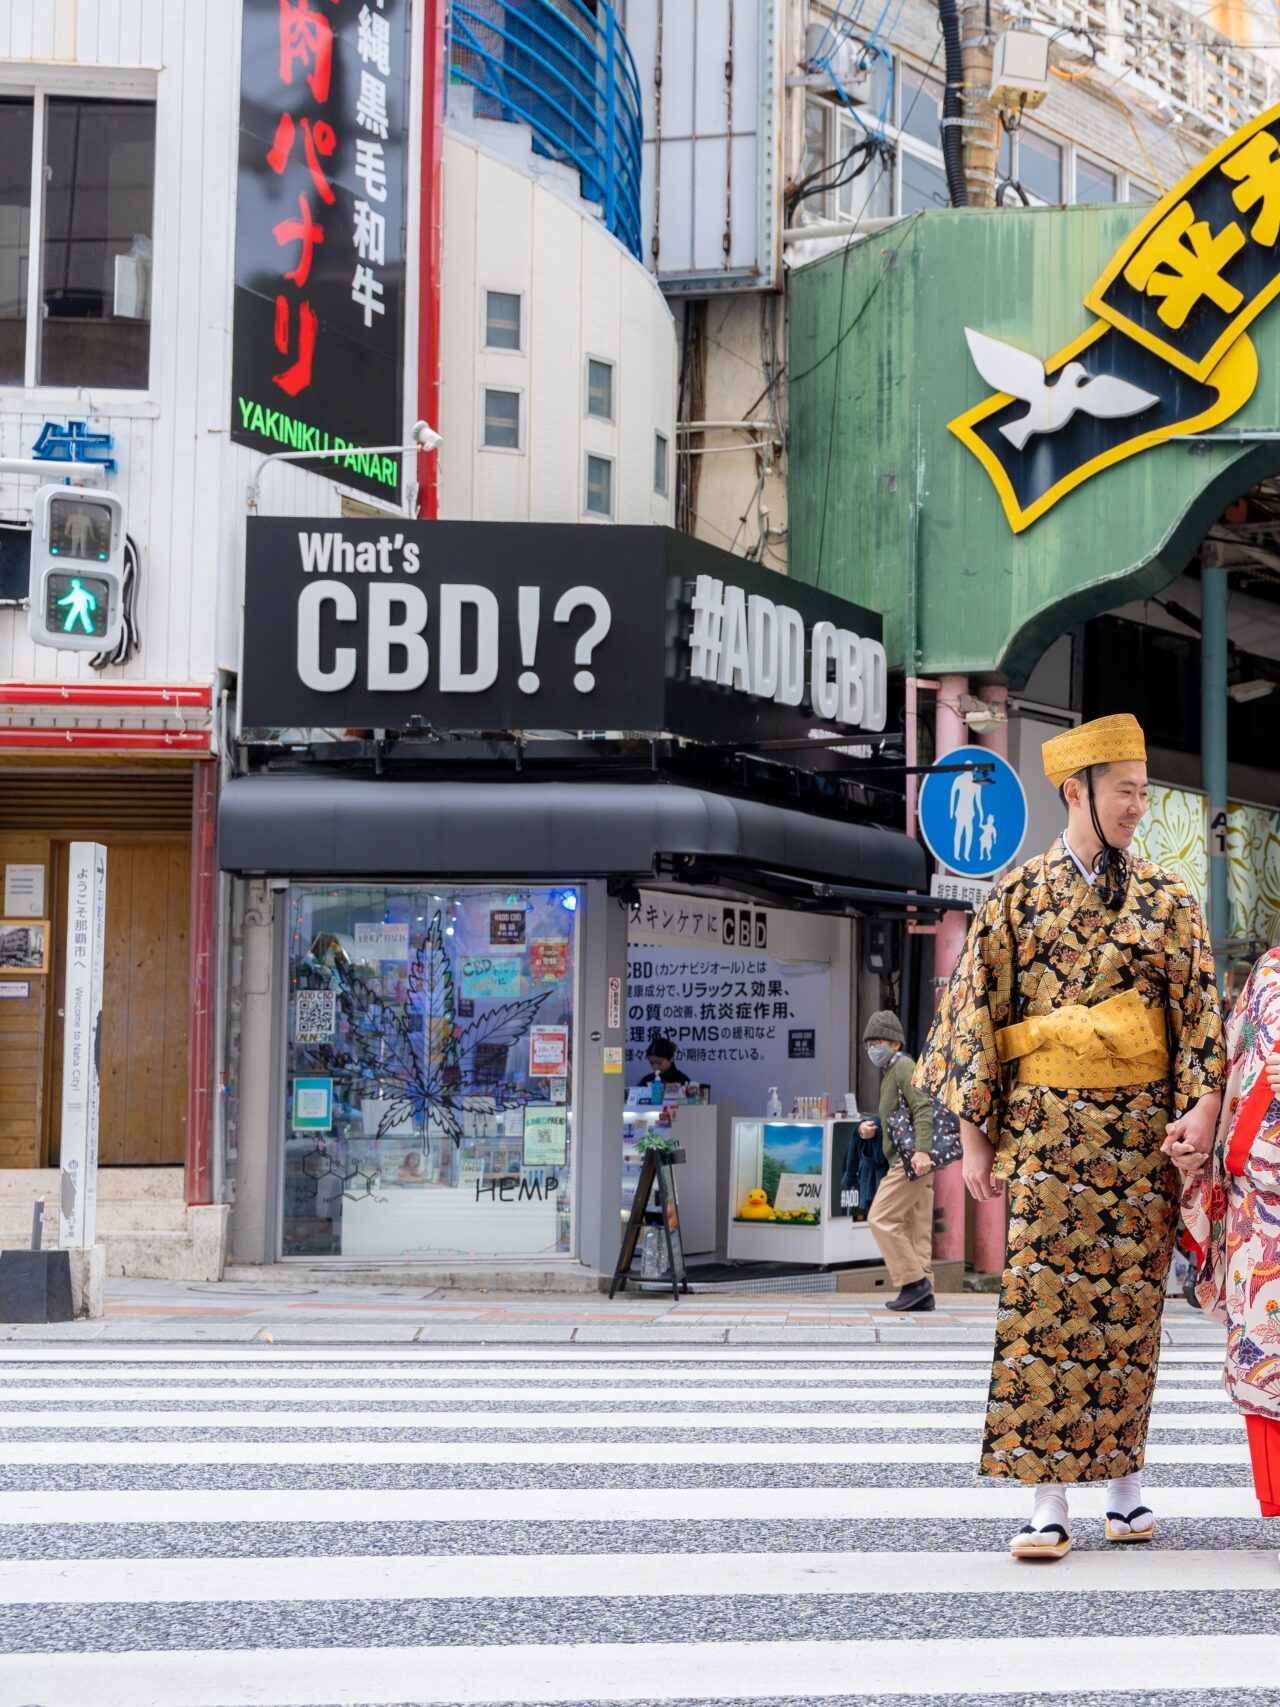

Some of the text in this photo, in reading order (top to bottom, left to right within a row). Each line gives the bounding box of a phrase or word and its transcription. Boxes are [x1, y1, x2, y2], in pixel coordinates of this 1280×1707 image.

[352, 0, 391, 328] 縄黒毛和牛
[265, 0, 337, 398] 肉パナリ
[238, 396, 398, 488] YAKINIKU PANARI
[299, 533, 421, 574] What's
[297, 580, 612, 693] CBD!?
[689, 574, 888, 732] #ADD CBD
[73, 867, 89, 968] ようこそ那覇市へ
[629, 904, 767, 948] スキンケアに CBD
[75, 986, 84, 1028] Welcome
[72, 1042, 82, 1067] Naha
[73, 1031, 81, 1040] to
[625, 1026, 776, 1044] 理痛やPMSの緩和など
[70, 1070, 81, 1092] City!
[475, 1176, 559, 1202] HEMP
[796, 1182, 823, 1198] JOIN
[840, 1189, 859, 1208] #ADD
